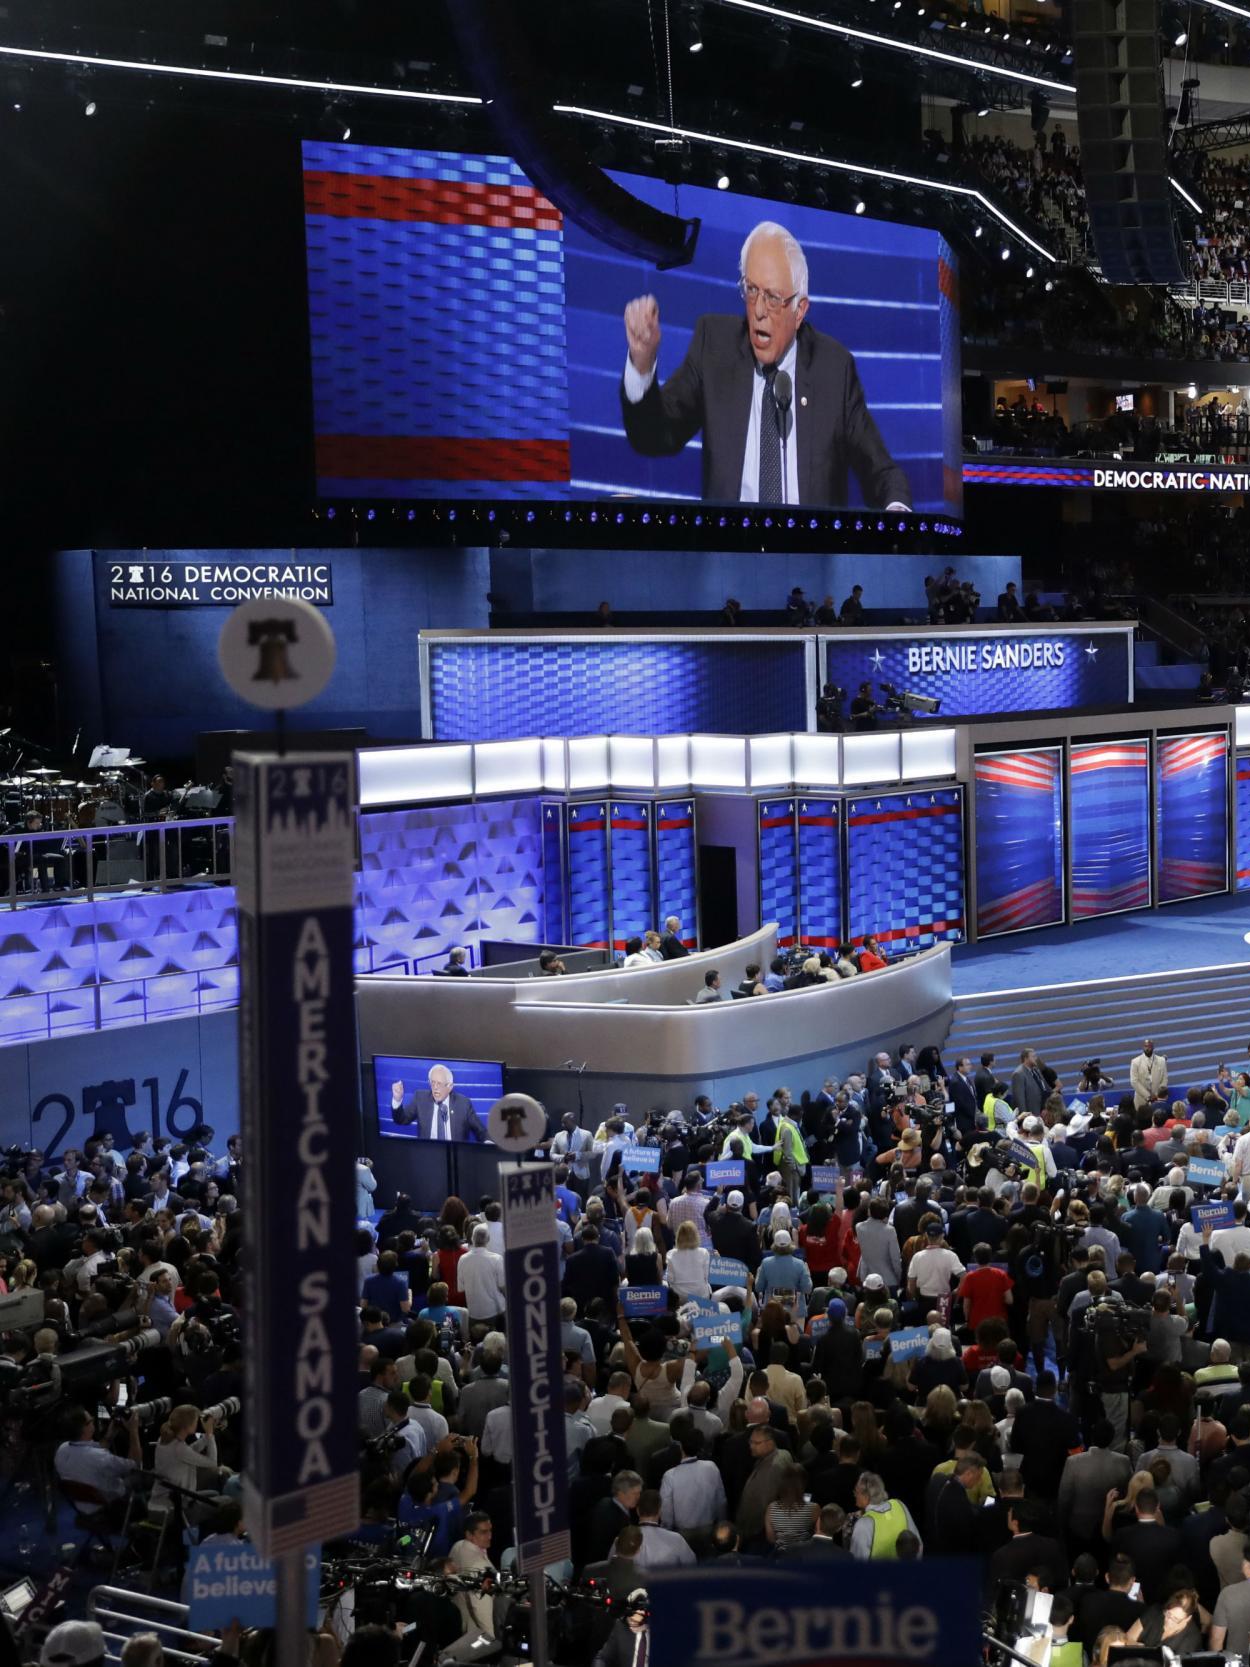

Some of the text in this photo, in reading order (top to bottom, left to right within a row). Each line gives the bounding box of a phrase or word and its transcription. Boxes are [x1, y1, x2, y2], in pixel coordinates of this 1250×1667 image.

[1094, 470, 1205, 490] DEMOCRATIC
[185, 566, 328, 583] DEMOCRATIC
[111, 587, 328, 601] NATIONAL CONVENTION
[908, 642, 1064, 673] BERNIE SANDERS
[293, 917, 332, 1252] AMERICAN
[710, 1167, 741, 1178] Bernie
[1189, 1162, 1224, 1177] Bernie
[1198, 1205, 1228, 1218] Bernie
[710, 1267, 739, 1277] believe
[718, 1260, 741, 1268] future
[626, 1290, 661, 1301] Bernie
[695, 1320, 740, 1337] Bernie
[892, 1332, 928, 1351] Bernie
[296, 1271, 333, 1483] SAMOA
[523, 1247, 555, 1535] CONNECTICUT
[194, 1554, 210, 1574] A
[215, 1551, 271, 1571] futur
[193, 1576, 277, 1599] believe
[695, 1590, 940, 1660] Bernie
